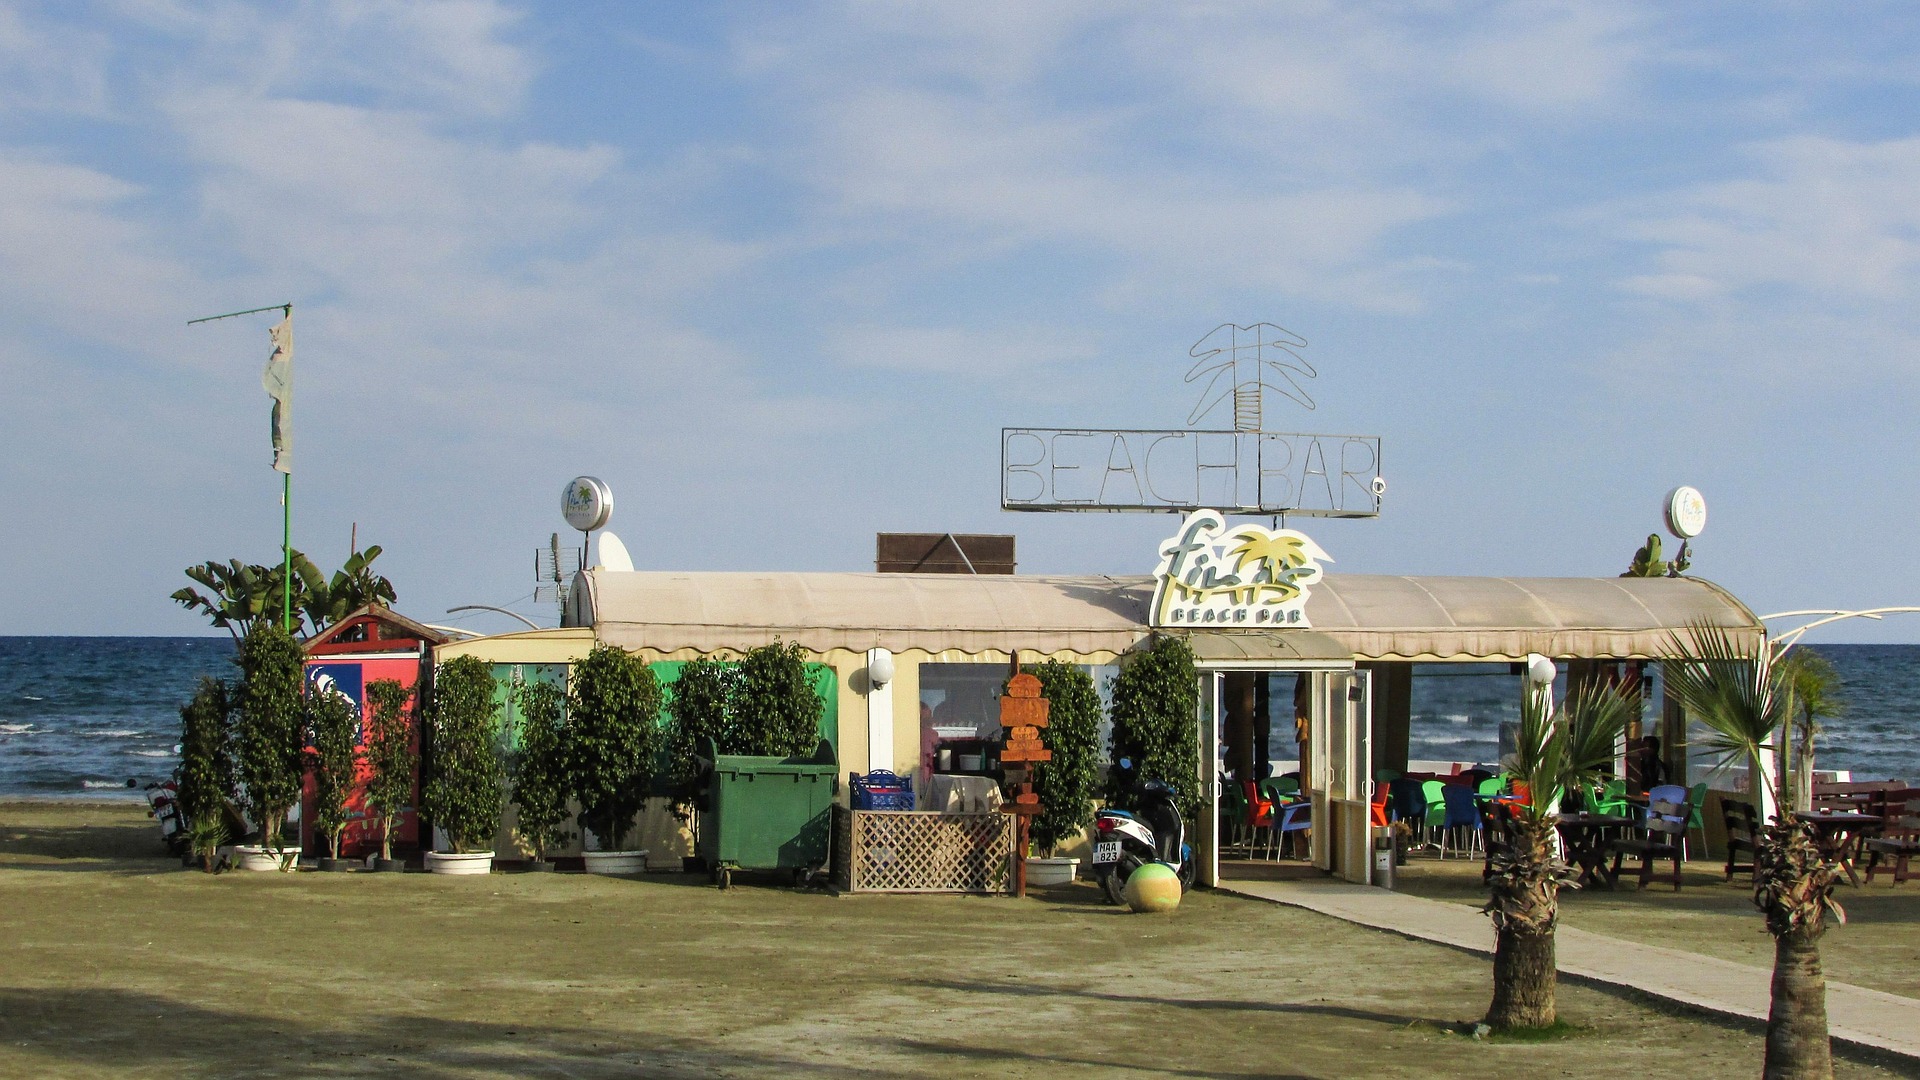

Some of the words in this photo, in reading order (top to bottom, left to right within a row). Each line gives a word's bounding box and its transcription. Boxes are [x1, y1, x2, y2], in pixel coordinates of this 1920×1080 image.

[1004, 431, 1238, 507] BEACH
[1259, 435, 1377, 511] BAR
[1173, 608, 1248, 623] BEACH
[1258, 609, 1301, 623] BAR
[1099, 842, 1117, 852] MAA
[1100, 852, 1117, 861] 823
